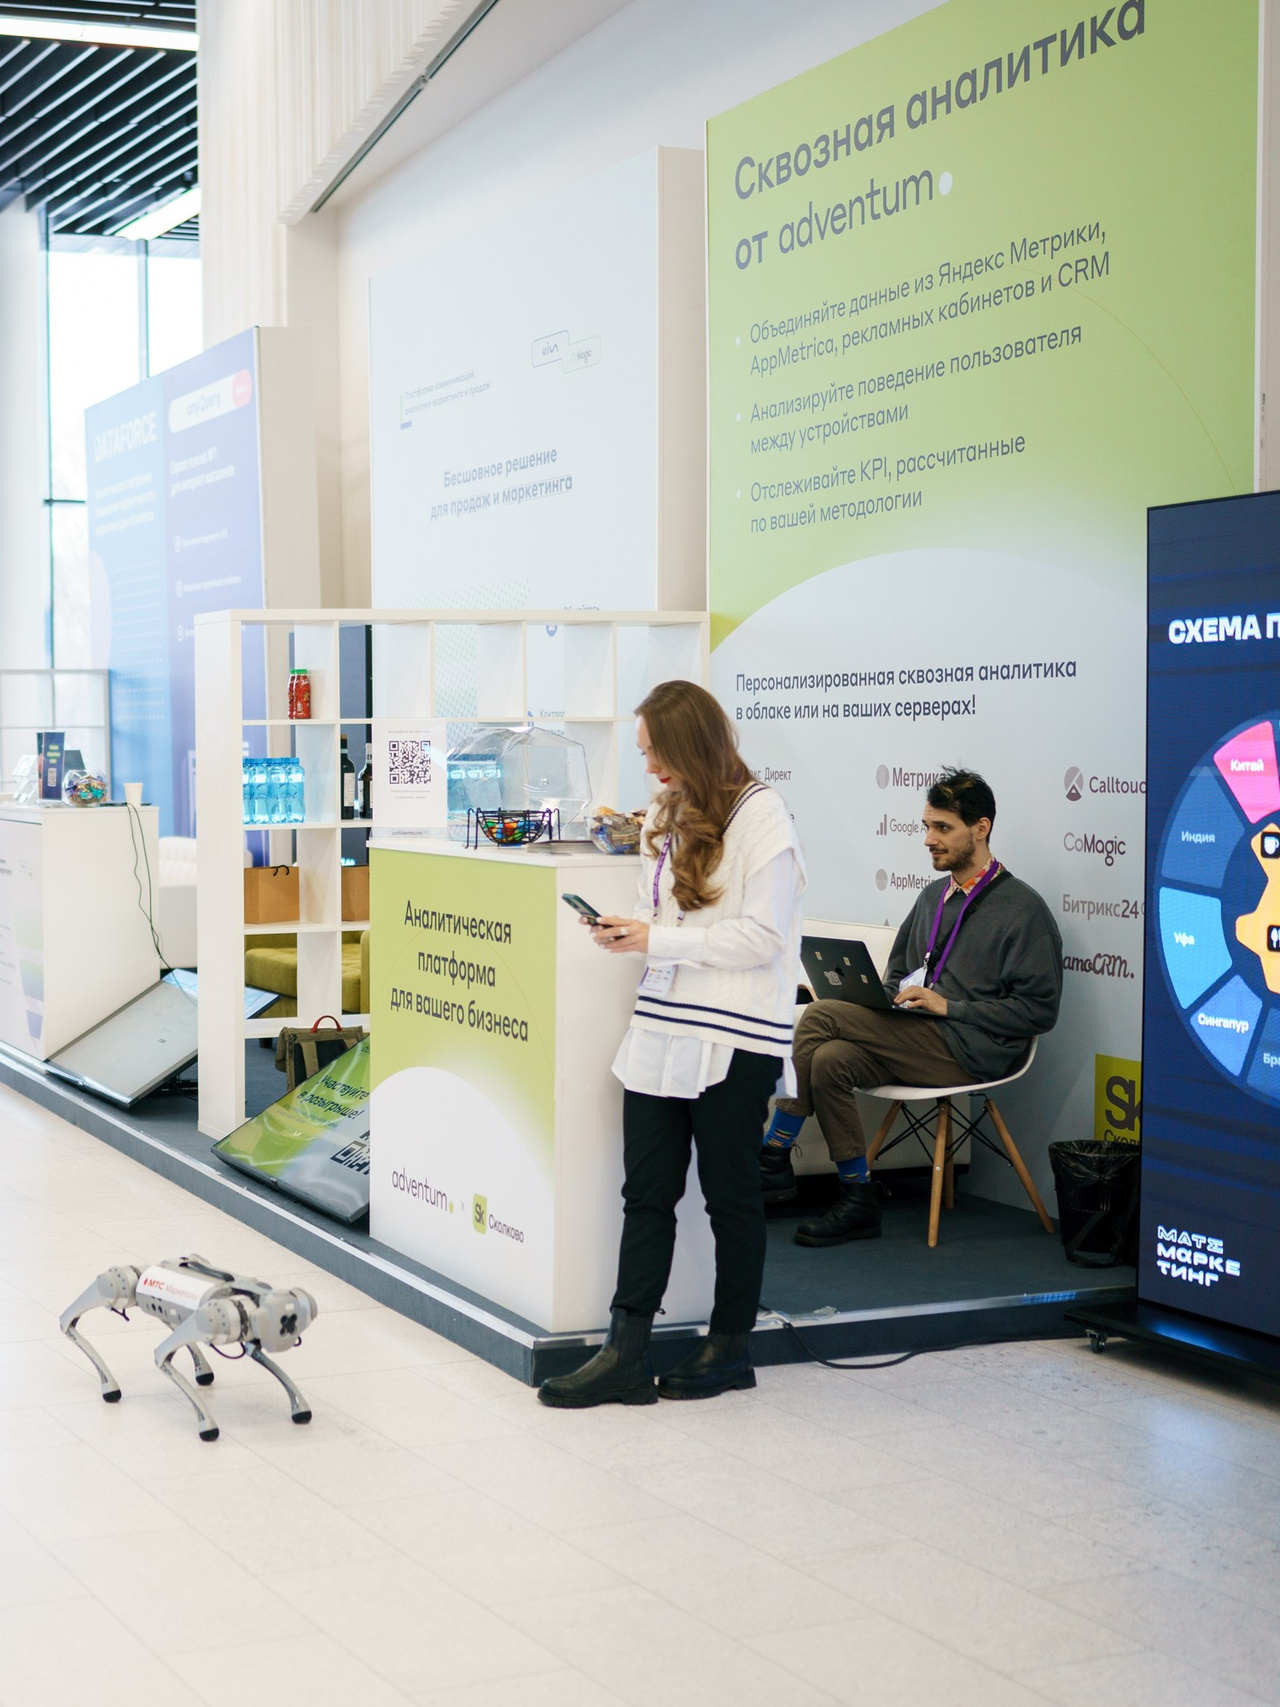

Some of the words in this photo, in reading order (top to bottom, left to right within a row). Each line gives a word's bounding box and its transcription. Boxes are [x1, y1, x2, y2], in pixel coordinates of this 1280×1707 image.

[734, 104, 896, 200] Сквозная
[905, 0, 1146, 130] аналитика
[734, 230, 769, 271] от
[751, 301, 846, 343] Объединяйте
[849, 281, 910, 316] данные
[914, 274, 934, 294] из
[938, 251, 1005, 287] Яндекс
[1010, 221, 1107, 265] Метрики,
[750, 337, 838, 378] AppMetrica,
[842, 308, 934, 355] рекламных
[938, 280, 1035, 322] кабинетов
[1041, 274, 1052, 294] и
[1058, 251, 1110, 287] CRM
[751, 382, 854, 423] Анализируйте
[857, 360, 945, 396] поведение
[950, 325, 1082, 374] пользователя
[751, 431, 796, 454] между
[799, 404, 909, 449] устройствами
[443, 461, 503, 488] Бесшовное
[506, 449, 557, 478] решение
[751, 466, 856, 502] Отслеживайте
[860, 456, 893, 483] KPI,
[896, 435, 1026, 481] рассчитанные
[430, 503, 449, 522] для
[450, 492, 491, 517] продаж
[493, 491, 500, 505] и
[502, 475, 573, 504] маркетинга
[751, 517, 767, 533] по
[770, 503, 816, 530] вашей
[820, 490, 922, 522] методологии
[1168, 614, 1262, 644] СХЕМА
[736, 670, 895, 695] Персонализированная
[898, 664, 974, 685] сквозная
[978, 660, 1077, 681] аналитика
[736, 707, 743, 720] в
[746, 701, 791, 720] облаке
[794, 705, 819, 719] или
[822, 704, 839, 719] на
[843, 701, 891, 718] ваших
[894, 694, 976, 721] серверах!
[764, 767, 792, 783] Директ
[1230, 758, 1264, 772] Китай
[889, 818, 919, 836] Google
[1181, 831, 1216, 844] Индия
[1063, 832, 1126, 867] CoMagic
[404, 899, 512, 945] Аналитическая
[1062, 894, 1140, 920] Битрикс24
[1173, 931, 1195, 947] Уфа
[418, 950, 496, 990] платформа
[390, 987, 413, 1012] для
[416, 993, 465, 1025] вашего
[467, 1000, 528, 1042] бизнеса
[1197, 1012, 1250, 1033] Сингапур
[317, 1074, 370, 1100] Участвуйте
[301, 1093, 365, 1120] розыгрыше!
[488, 1214, 525, 1243] Сколково
[1156, 1259, 1219, 1287] ТИНГ
